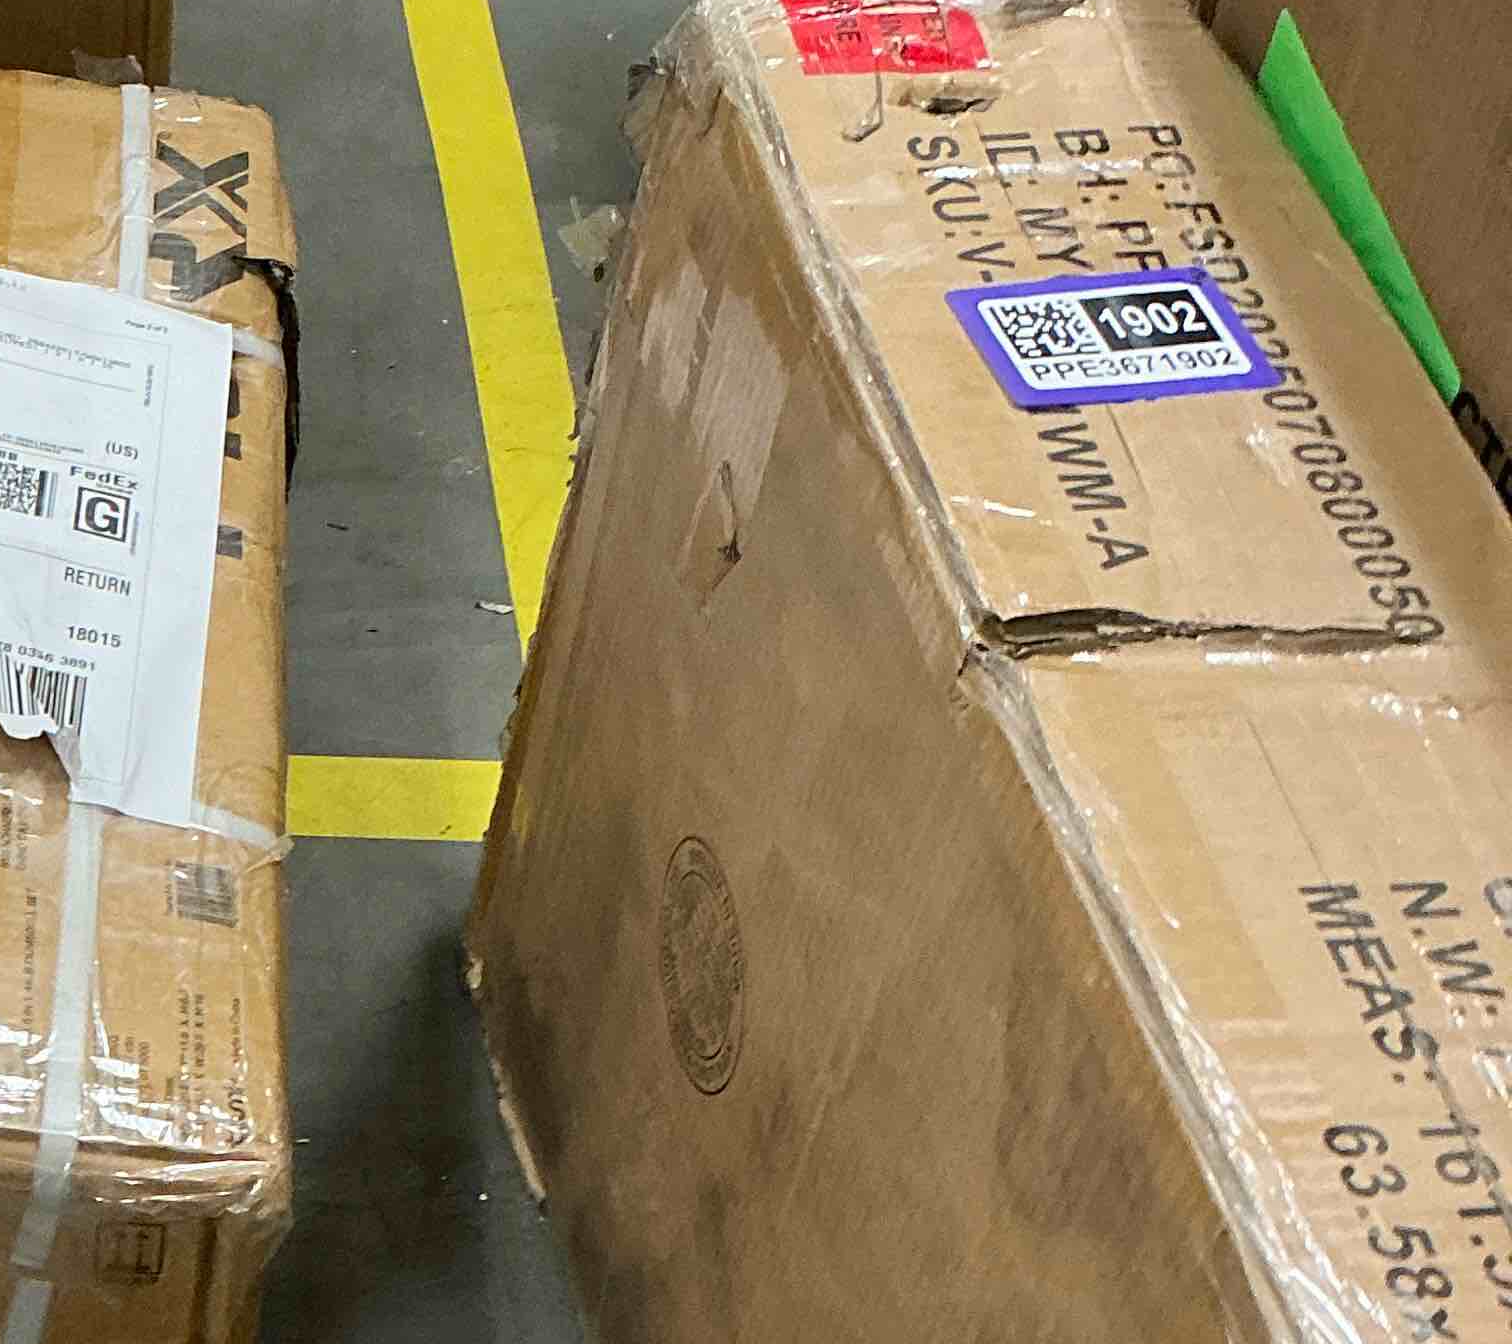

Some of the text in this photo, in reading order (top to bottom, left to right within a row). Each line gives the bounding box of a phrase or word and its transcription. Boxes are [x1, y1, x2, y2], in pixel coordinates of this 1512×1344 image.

[1097, 299, 1207, 339] 1902
[1028, 346, 1241, 382] PPE3671902
[104, 438, 140, 462] (US)
[68, 464, 139, 492] FedEx
[84, 495, 120, 535] G
[63, 566, 132, 597] RETURN
[65, 624, 122, 649] 18015
